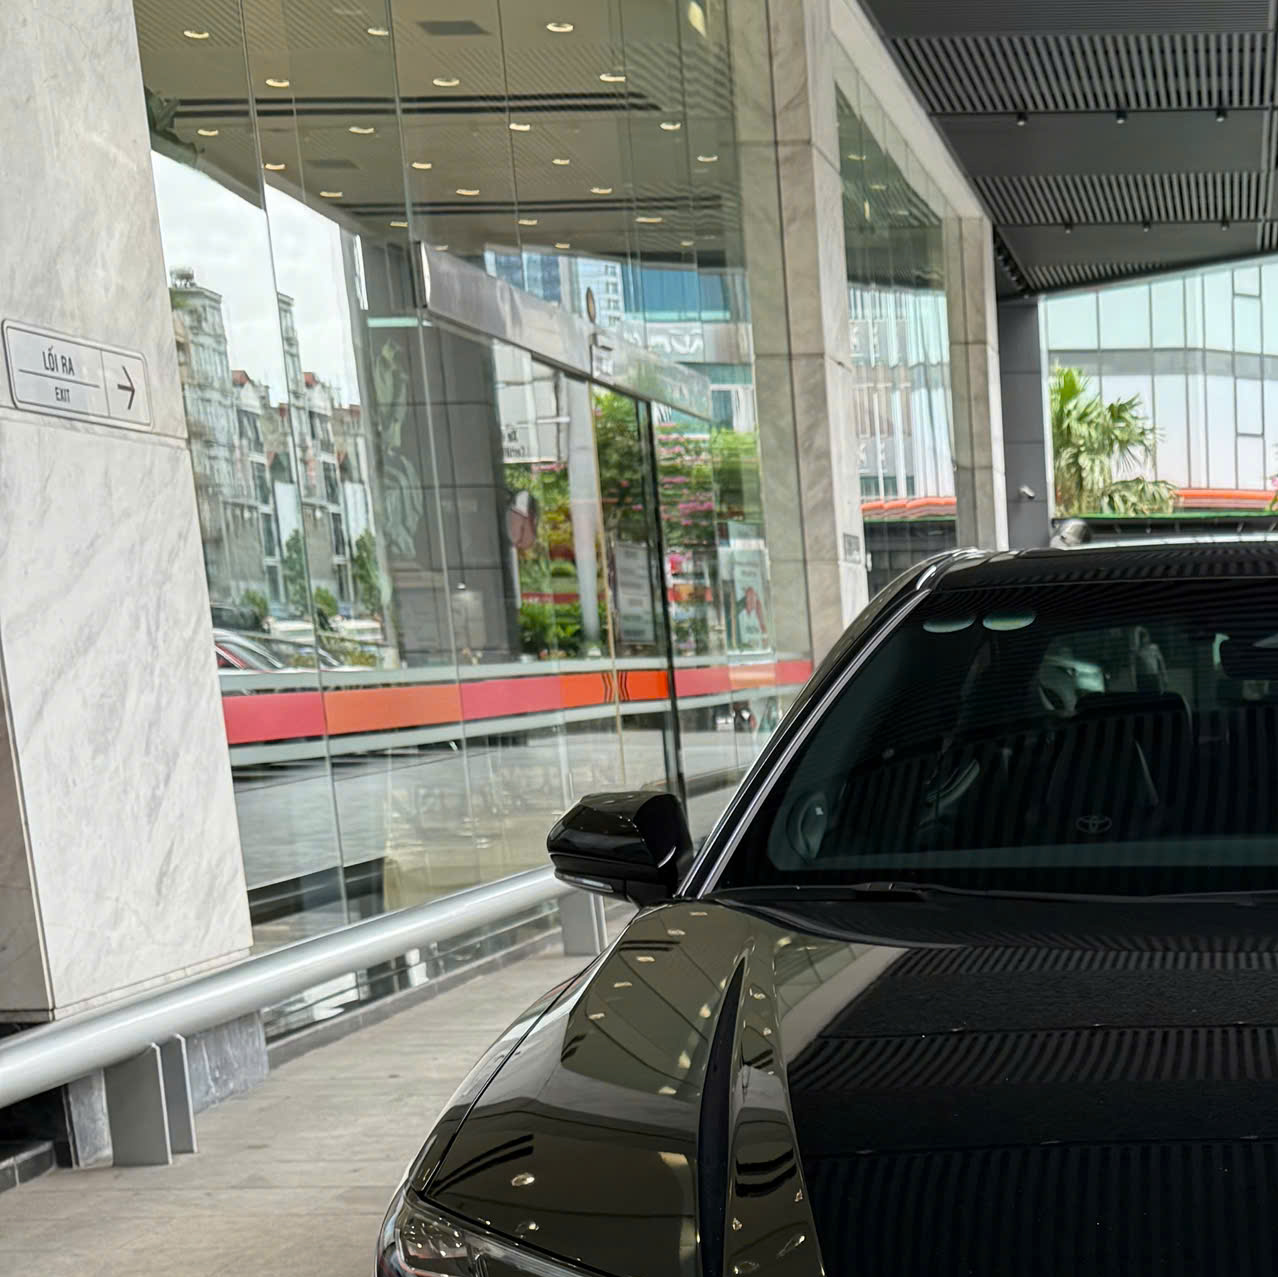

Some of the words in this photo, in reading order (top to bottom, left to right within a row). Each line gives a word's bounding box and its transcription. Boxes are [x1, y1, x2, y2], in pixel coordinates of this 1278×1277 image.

[42, 346, 58, 372] LỐI
[61, 355, 74, 376] RA
[55, 387, 70, 402] EXIT
